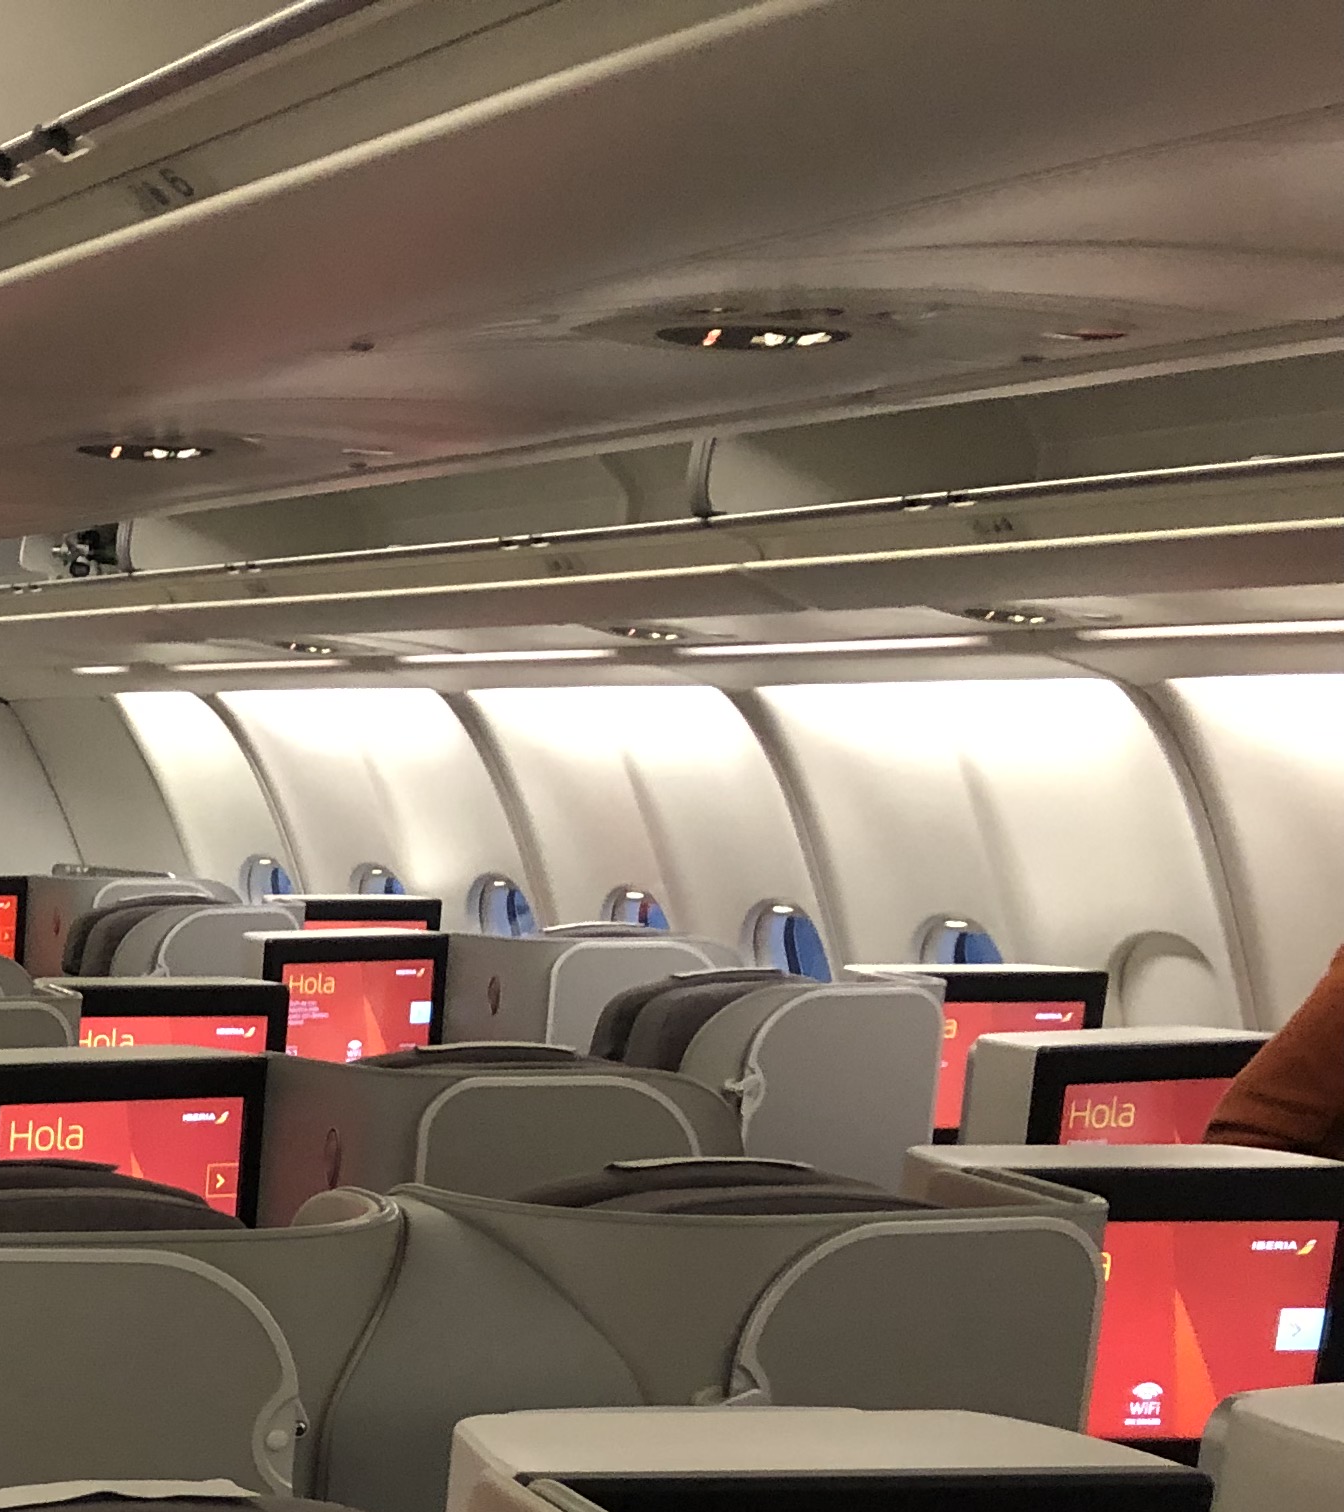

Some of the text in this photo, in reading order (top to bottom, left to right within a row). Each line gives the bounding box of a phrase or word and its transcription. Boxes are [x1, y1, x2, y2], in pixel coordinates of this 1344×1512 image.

[288, 972, 335, 994] Hola
[1070, 1097, 1135, 1128] Hola
[10, 1117, 83, 1151] Hola
